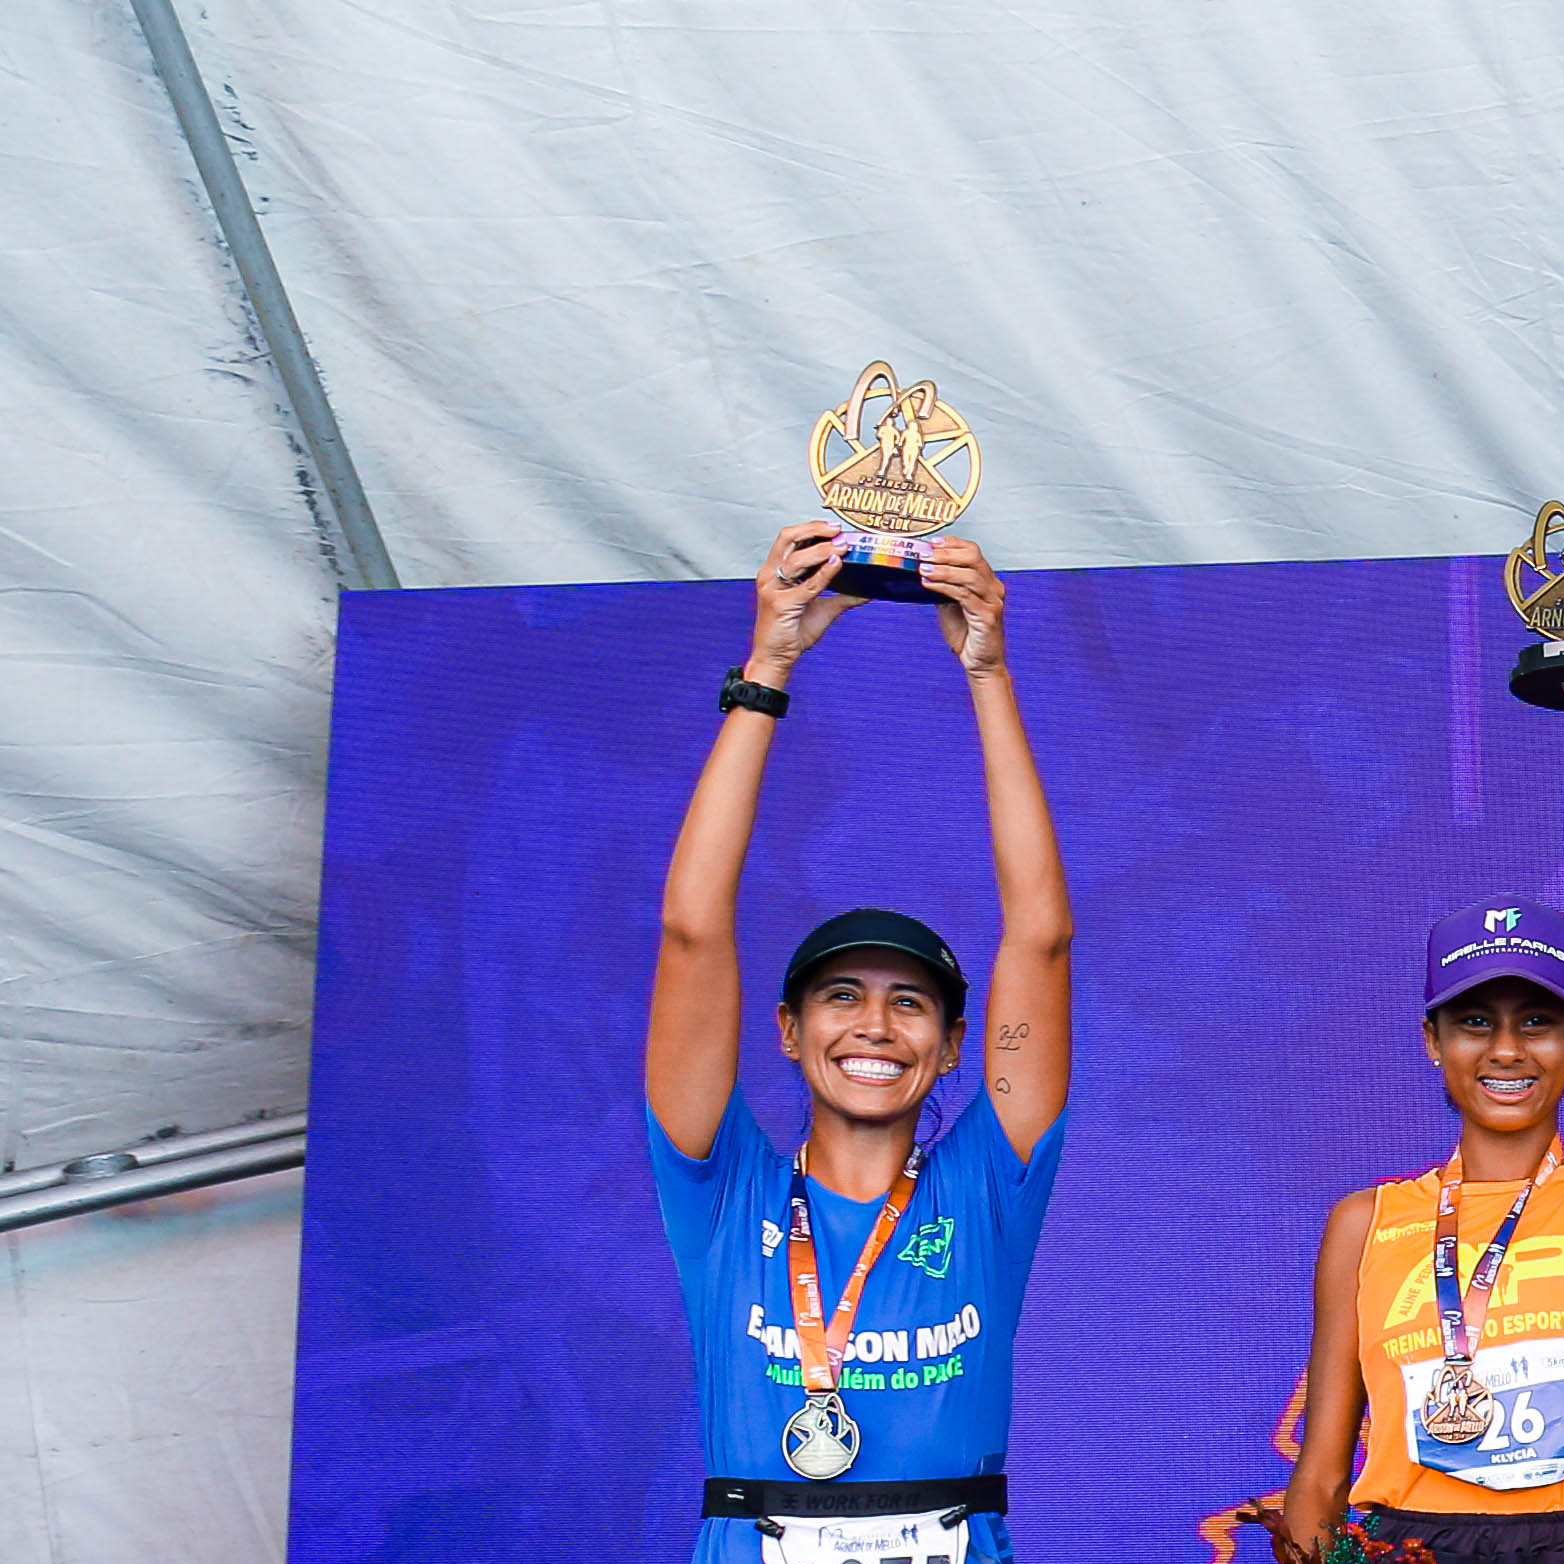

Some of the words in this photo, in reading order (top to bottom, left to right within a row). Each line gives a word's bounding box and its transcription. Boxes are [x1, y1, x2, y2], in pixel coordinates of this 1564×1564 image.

[825, 483, 887, 512] ARNON
[886, 493, 903, 512] DE
[902, 492, 958, 522] MELLO
[874, 537, 914, 549] LUGAR
[1441, 938, 1507, 967] MIRELLE
[891, 1368, 920, 1390] do
[1485, 1372, 1511, 1387] MELLO
[1477, 1391, 1545, 1452] 26
[1490, 1447, 1537, 1465] KLYCIA
